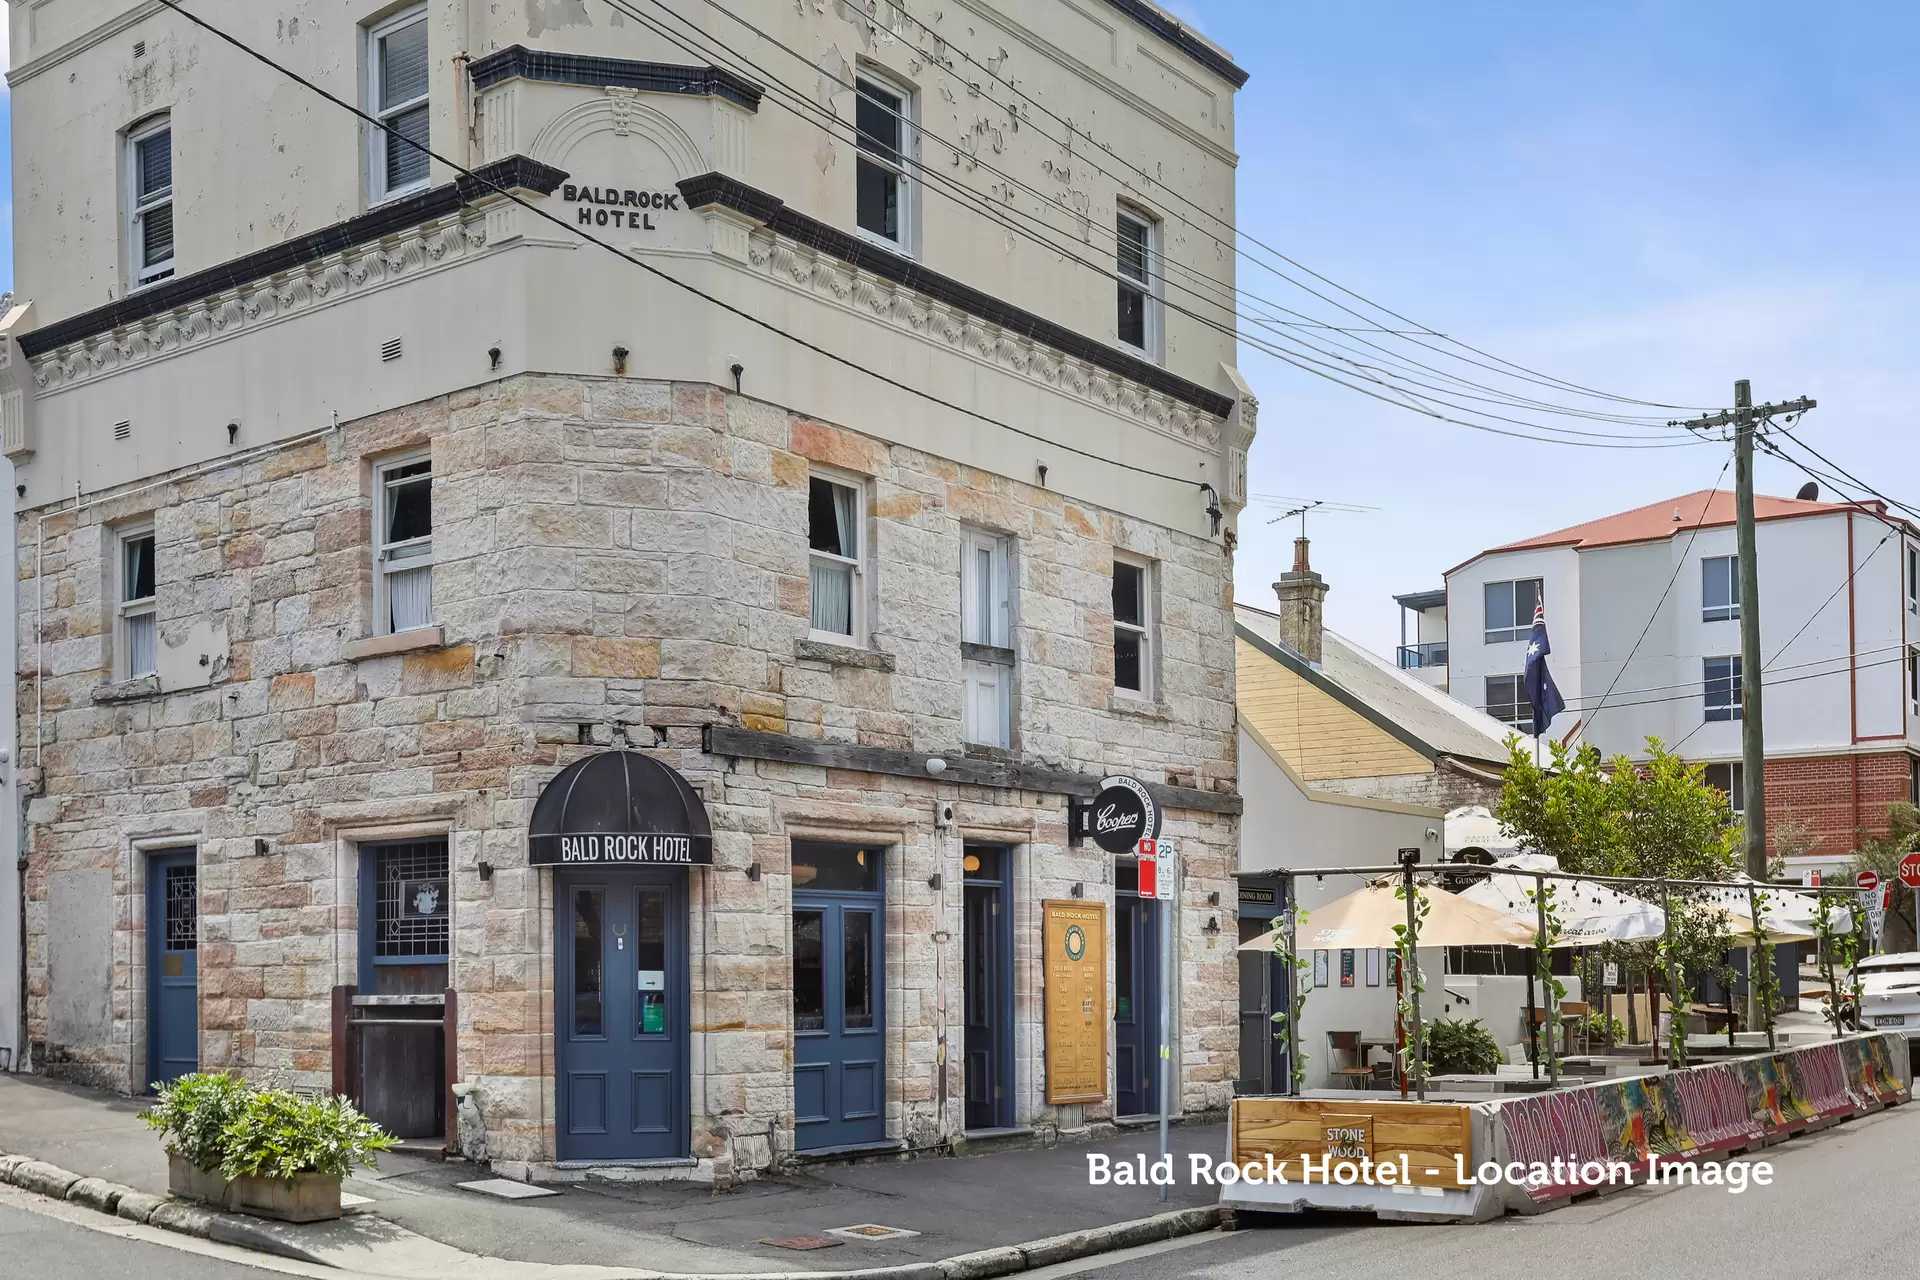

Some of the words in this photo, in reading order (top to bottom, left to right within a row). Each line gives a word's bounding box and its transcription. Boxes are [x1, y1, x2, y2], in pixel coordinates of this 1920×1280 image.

[578, 207, 656, 230] HOTEL
[1118, 777, 1137, 789] BALD
[1137, 786, 1152, 808] ROCK
[1097, 803, 1139, 834] Coopers
[1143, 810, 1154, 837] HOTEL
[561, 837, 599, 861] BALD
[604, 835, 648, 860] ROCK
[653, 836, 692, 862] HOTEL
[1158, 844, 1172, 858] 2P
[1901, 862, 1920, 876] STO
[1455, 876, 1484, 885] GUINN
[1256, 893, 1272, 901] ROOM
[1864, 891, 1876, 899] NO
[1051, 911, 1066, 919] BALD
[1066, 912, 1081, 920] ROCK
[1327, 1128, 1365, 1142] STONE
[1327, 1144, 1366, 1159] WOOD
